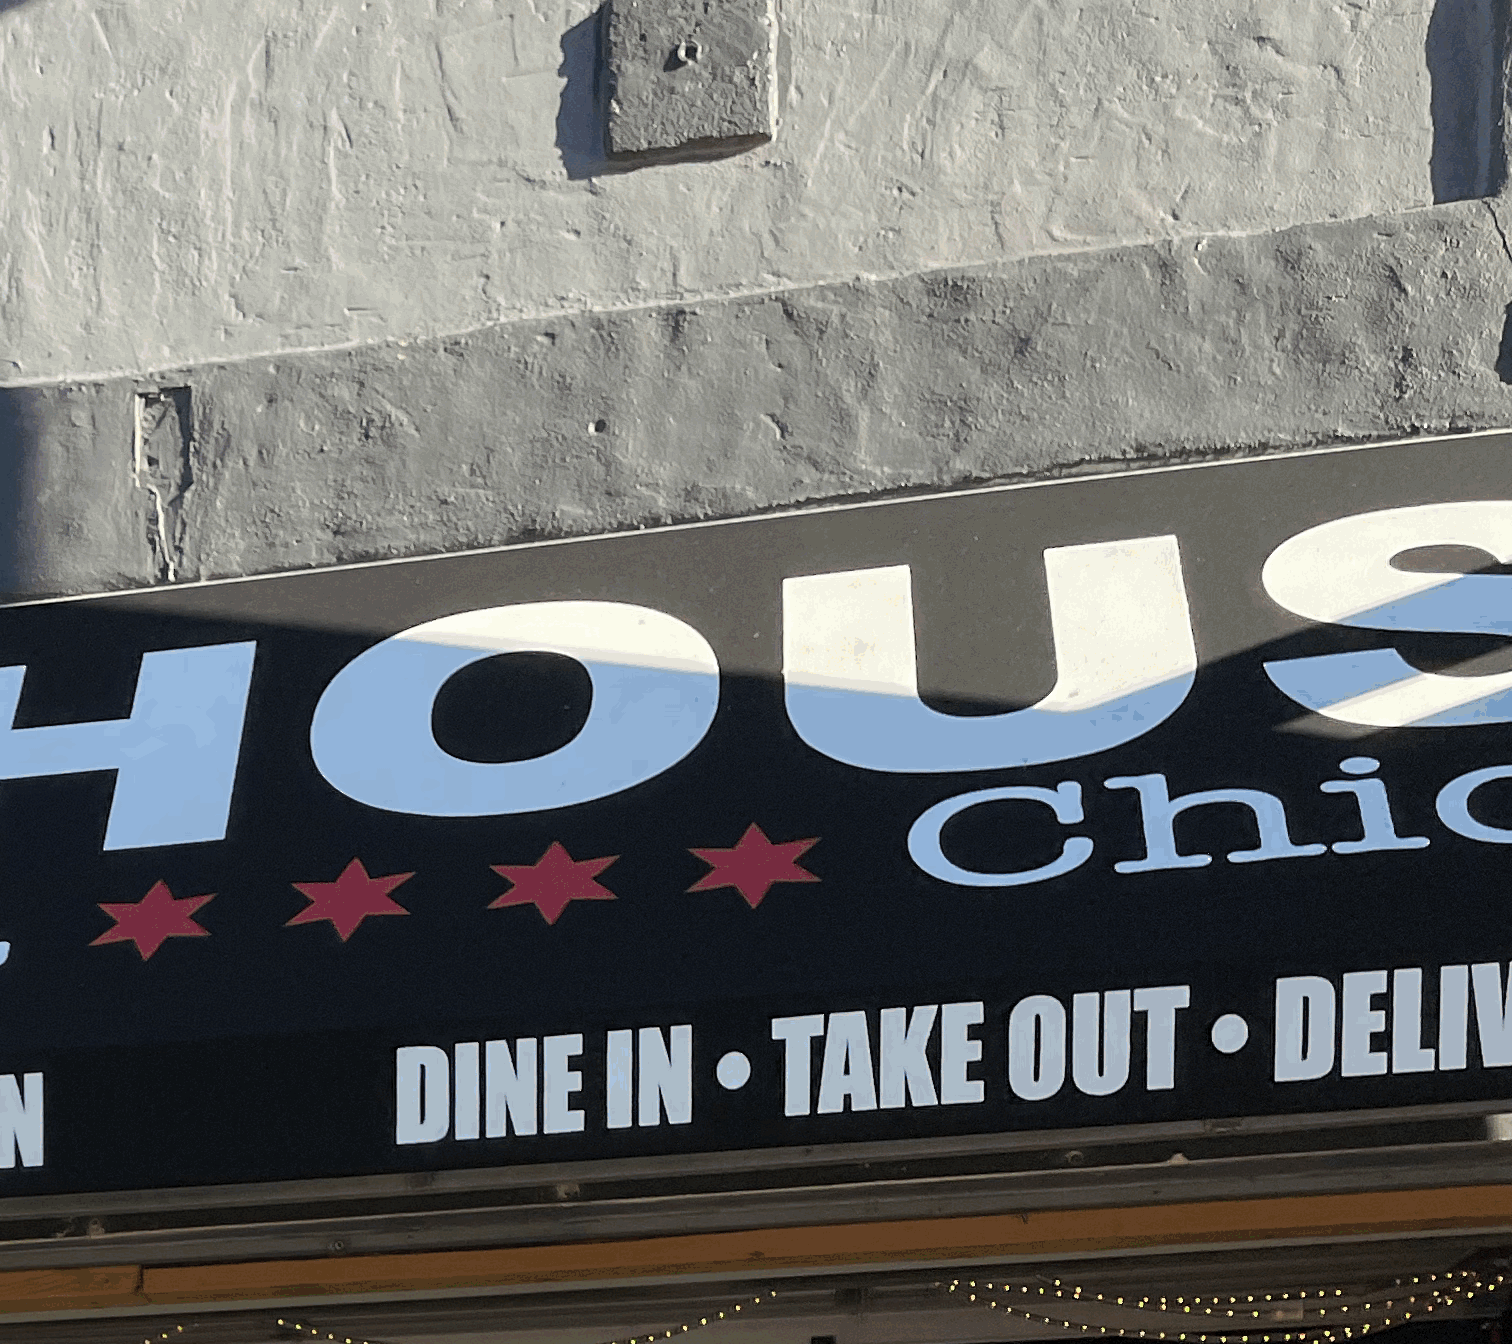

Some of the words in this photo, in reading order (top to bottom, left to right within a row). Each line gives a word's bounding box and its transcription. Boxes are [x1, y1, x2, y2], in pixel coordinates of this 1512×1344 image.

[395, 1032, 583, 1146] DINE
[605, 1023, 694, 1129] IN
[772, 1000, 986, 1118] TAKE
[1007, 983, 1190, 1103] OUT
